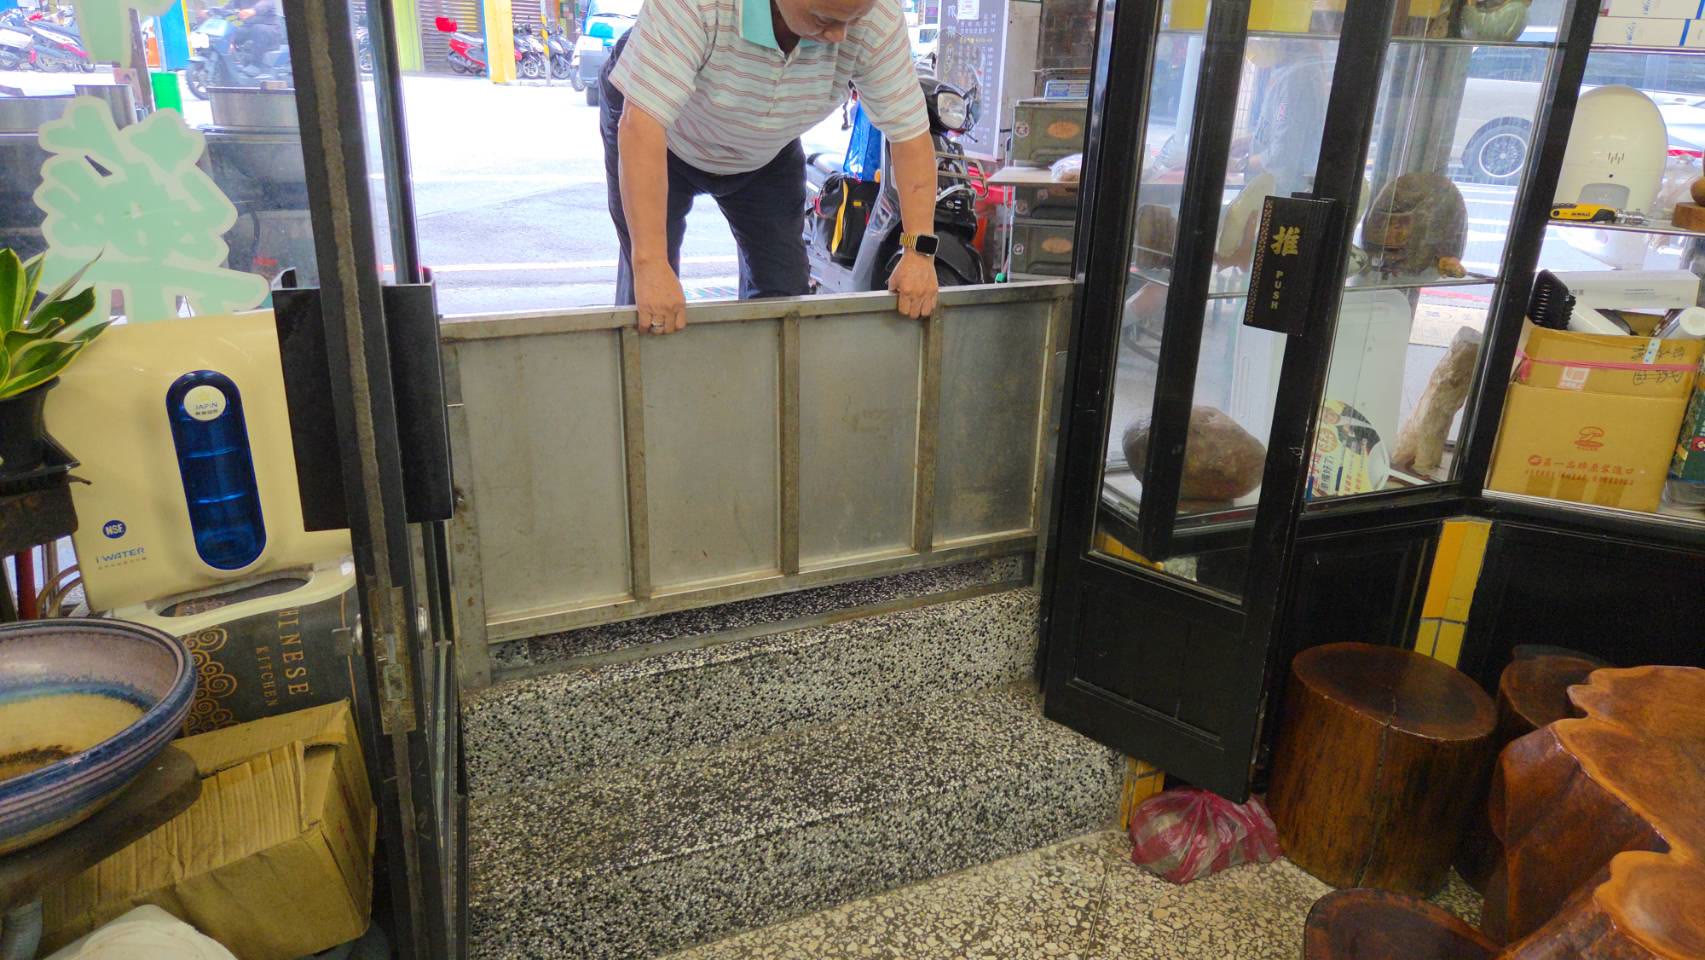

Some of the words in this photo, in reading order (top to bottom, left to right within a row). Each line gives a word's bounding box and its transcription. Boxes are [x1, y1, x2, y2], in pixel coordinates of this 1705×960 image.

[1270, 226, 1300, 256] 推
[1269, 270, 1286, 310] PUSH
[104, 522, 124, 537] NSF
[278, 608, 309, 695] HINESE
[256, 646, 279, 706] KITCHEN
